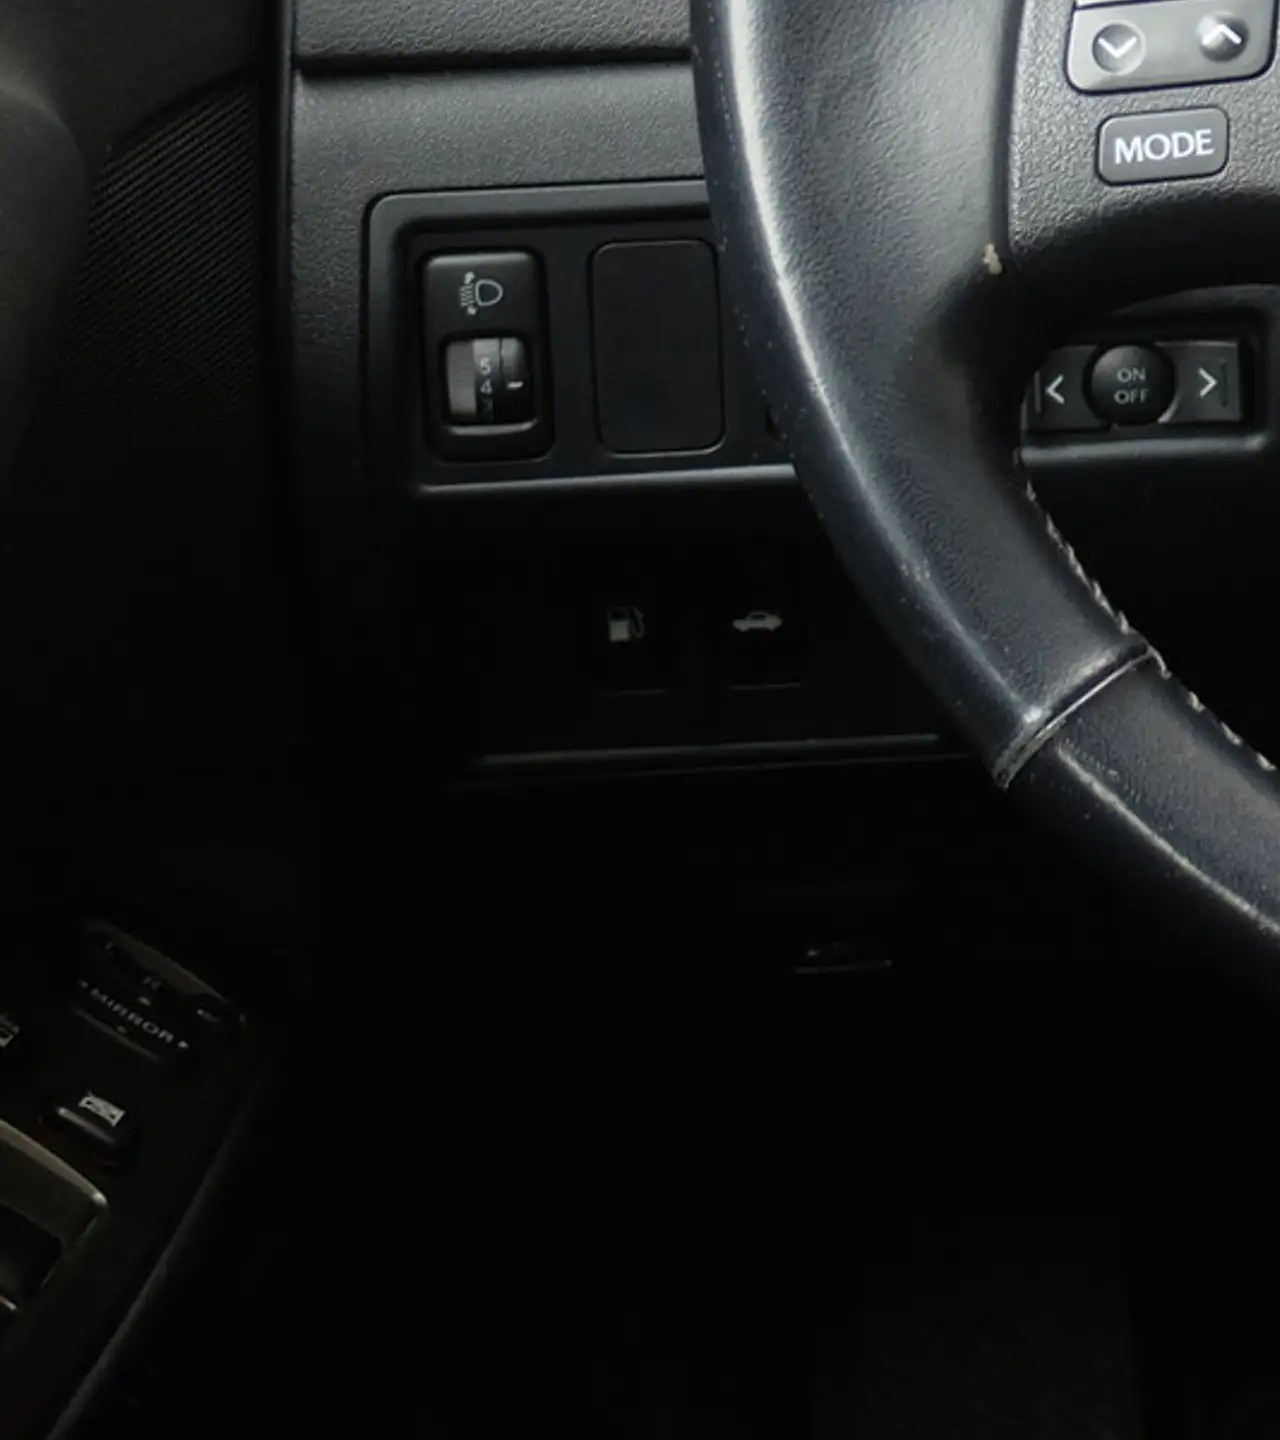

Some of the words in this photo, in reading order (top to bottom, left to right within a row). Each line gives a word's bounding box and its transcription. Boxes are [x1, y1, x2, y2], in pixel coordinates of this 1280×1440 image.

[1114, 128, 1215, 165] MODE
[1116, 368, 1147, 383] ON
[1114, 388, 1149, 405] OFF
